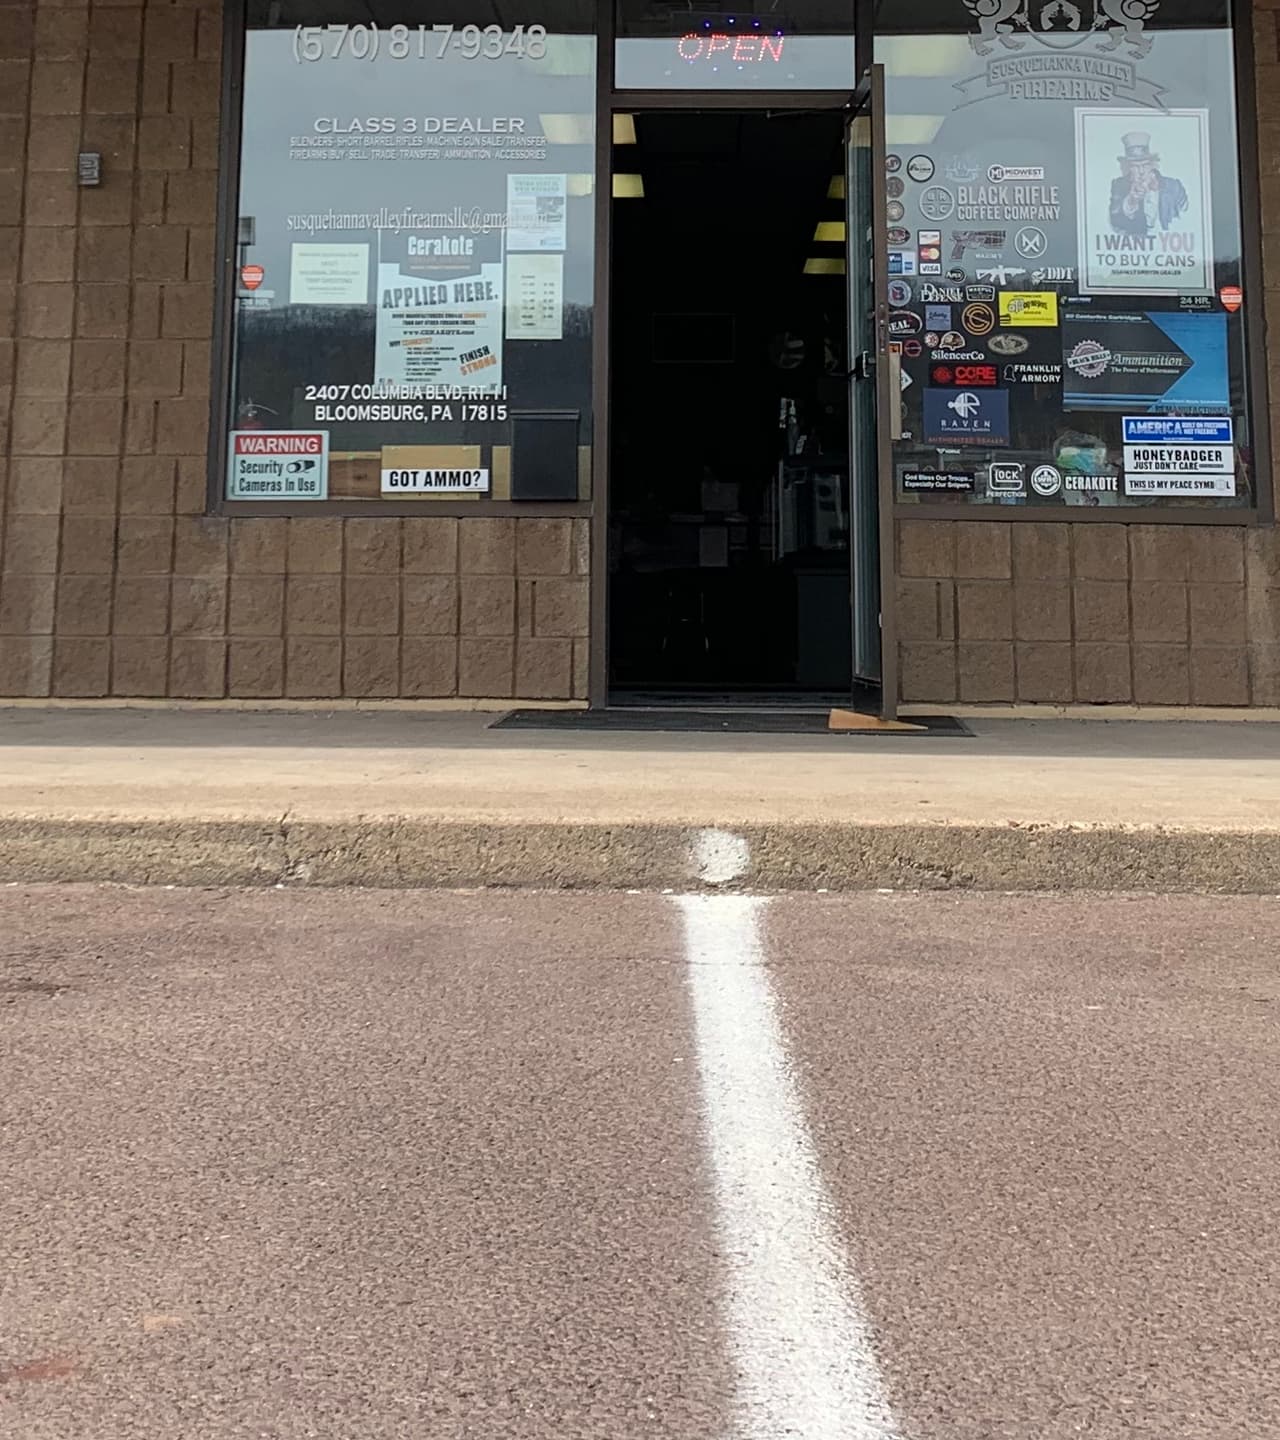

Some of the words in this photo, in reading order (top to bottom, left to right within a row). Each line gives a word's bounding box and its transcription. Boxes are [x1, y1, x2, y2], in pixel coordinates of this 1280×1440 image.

[293, 22, 380, 61] (570)
[388, 25, 547, 59] 817-9348
[677, 33, 785, 62] OPEN
[991, 56, 1081, 80] SUSQUEHANNA
[1083, 58, 1130, 82] VALLEY
[1009, 80, 1113, 101] FIREARMS
[314, 117, 396, 134] CLASS
[402, 117, 417, 133] 3
[424, 117, 525, 133] DEALER
[1005, 168, 1042, 176] MIDWEST
[958, 186, 1008, 205] BLACK
[1014, 186, 1060, 205] RIFLE
[958, 206, 1001, 221] COFFEE
[1004, 206, 1061, 221] COMPANY
[407, 235, 474, 256] Cerakote
[1096, 235, 1100, 250] I
[1104, 234, 1156, 251] WANT
[1158, 232, 1194, 252] YOU
[1096, 254, 1116, 266] TO
[1121, 254, 1150, 267] BUY
[1155, 255, 1195, 267] CANS
[1047, 267, 1074, 280] DDT
[382, 284, 448, 308] APPLIED
[454, 281, 498, 303] HERE.
[459, 345, 490, 364] FINISH
[931, 351, 985, 361] SilencerCo
[1111, 354, 1183, 366] Ammunition
[955, 367, 996, 379] CORE
[1014, 365, 1061, 373] FRANKLIN
[1021, 375, 1061, 383] ARMORY
[305, 385, 350, 400] 2407
[351, 384, 422, 400] COLUMBIA
[315, 405, 429, 423] BLOOMSBURG,
[432, 405, 453, 421] PA
[461, 405, 507, 421] 17815
[1128, 421, 1183, 435] AMERICA
[239, 438, 318, 453] WARNING
[1134, 450, 1222, 461] HONEYBADGER
[239, 460, 283, 476] Security
[1133, 462, 1153, 470] JUST
[1155, 462, 1177, 470] DON'T
[1179, 462, 1199, 470] CARE
[239, 478, 282, 493] Cameras
[285, 478, 295, 492] In
[298, 478, 316, 492] Use
[389, 471, 419, 487] GOT
[423, 471, 481, 487] AMMO?
[1065, 476, 1119, 491] CERAKOTE
[1129, 481, 1146, 489] THIS
[1148, 481, 1155, 489] IS
[1157, 481, 1168, 489] MY
[1170, 481, 1192, 489] PEACE
